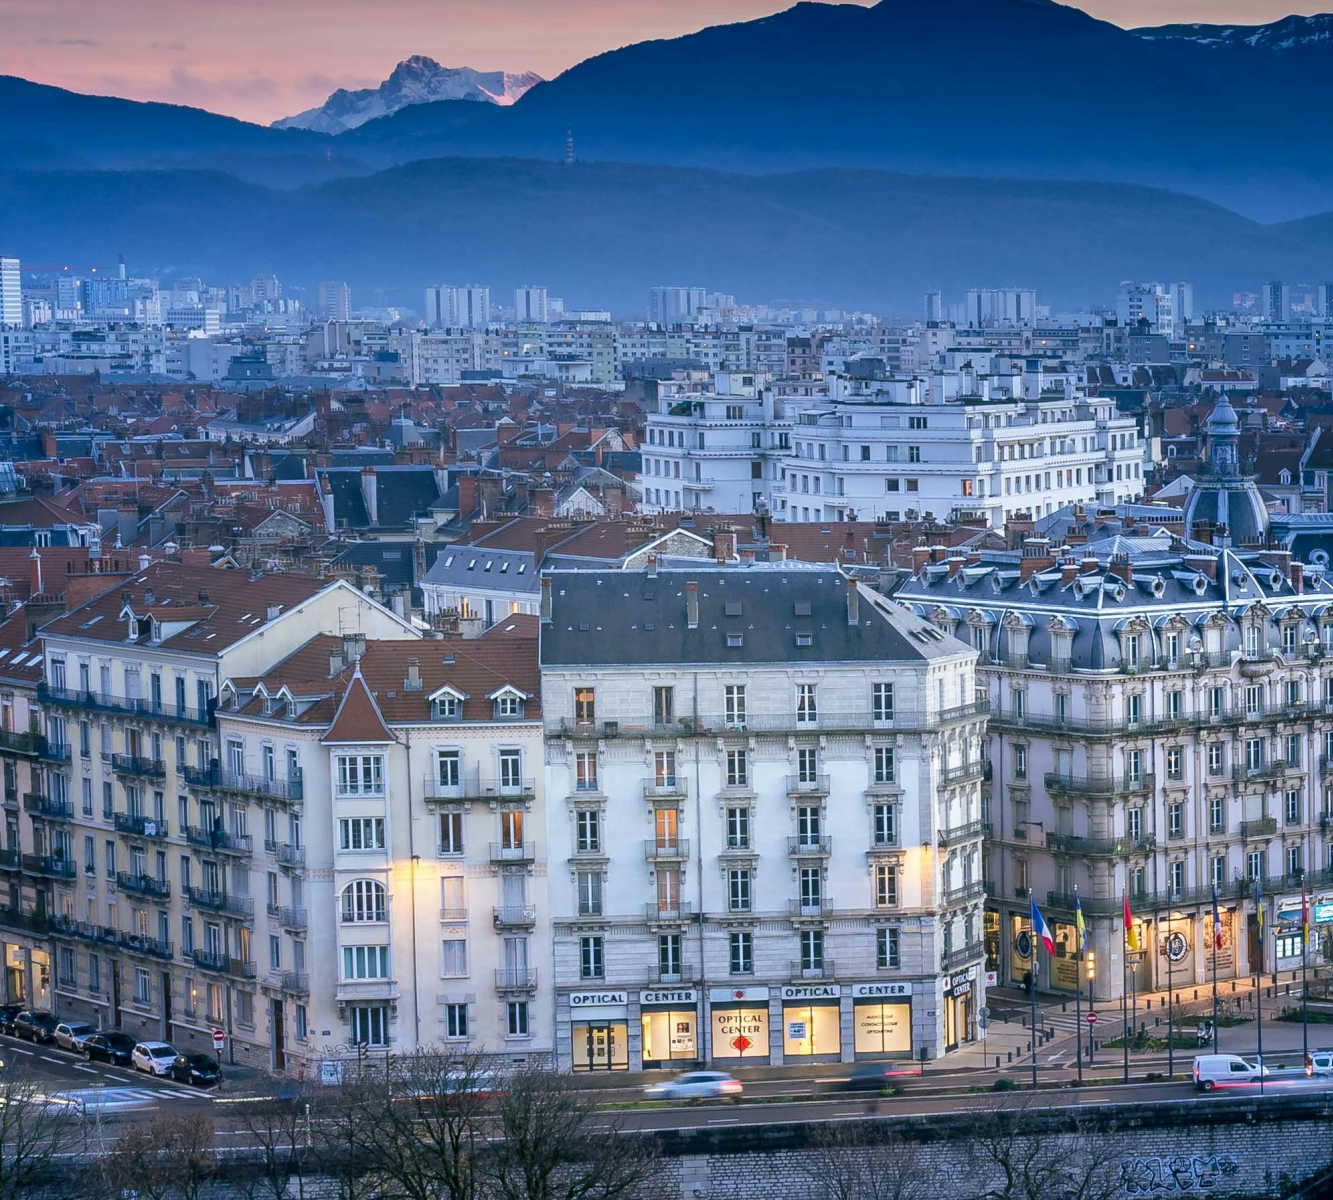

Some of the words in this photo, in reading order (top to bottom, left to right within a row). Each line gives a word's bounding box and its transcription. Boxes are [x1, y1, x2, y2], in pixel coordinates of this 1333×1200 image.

[952, 973, 969, 986] OPTICA
[785, 987, 836, 997] OPTICAL
[859, 985, 905, 995] CENTER
[954, 983, 970, 996] CENTER
[573, 994, 624, 1004] OPTICAL
[645, 992, 692, 1002] CENTER
[718, 1015, 763, 1023] OPTICAL
[721, 1025, 760, 1034] CENTER
